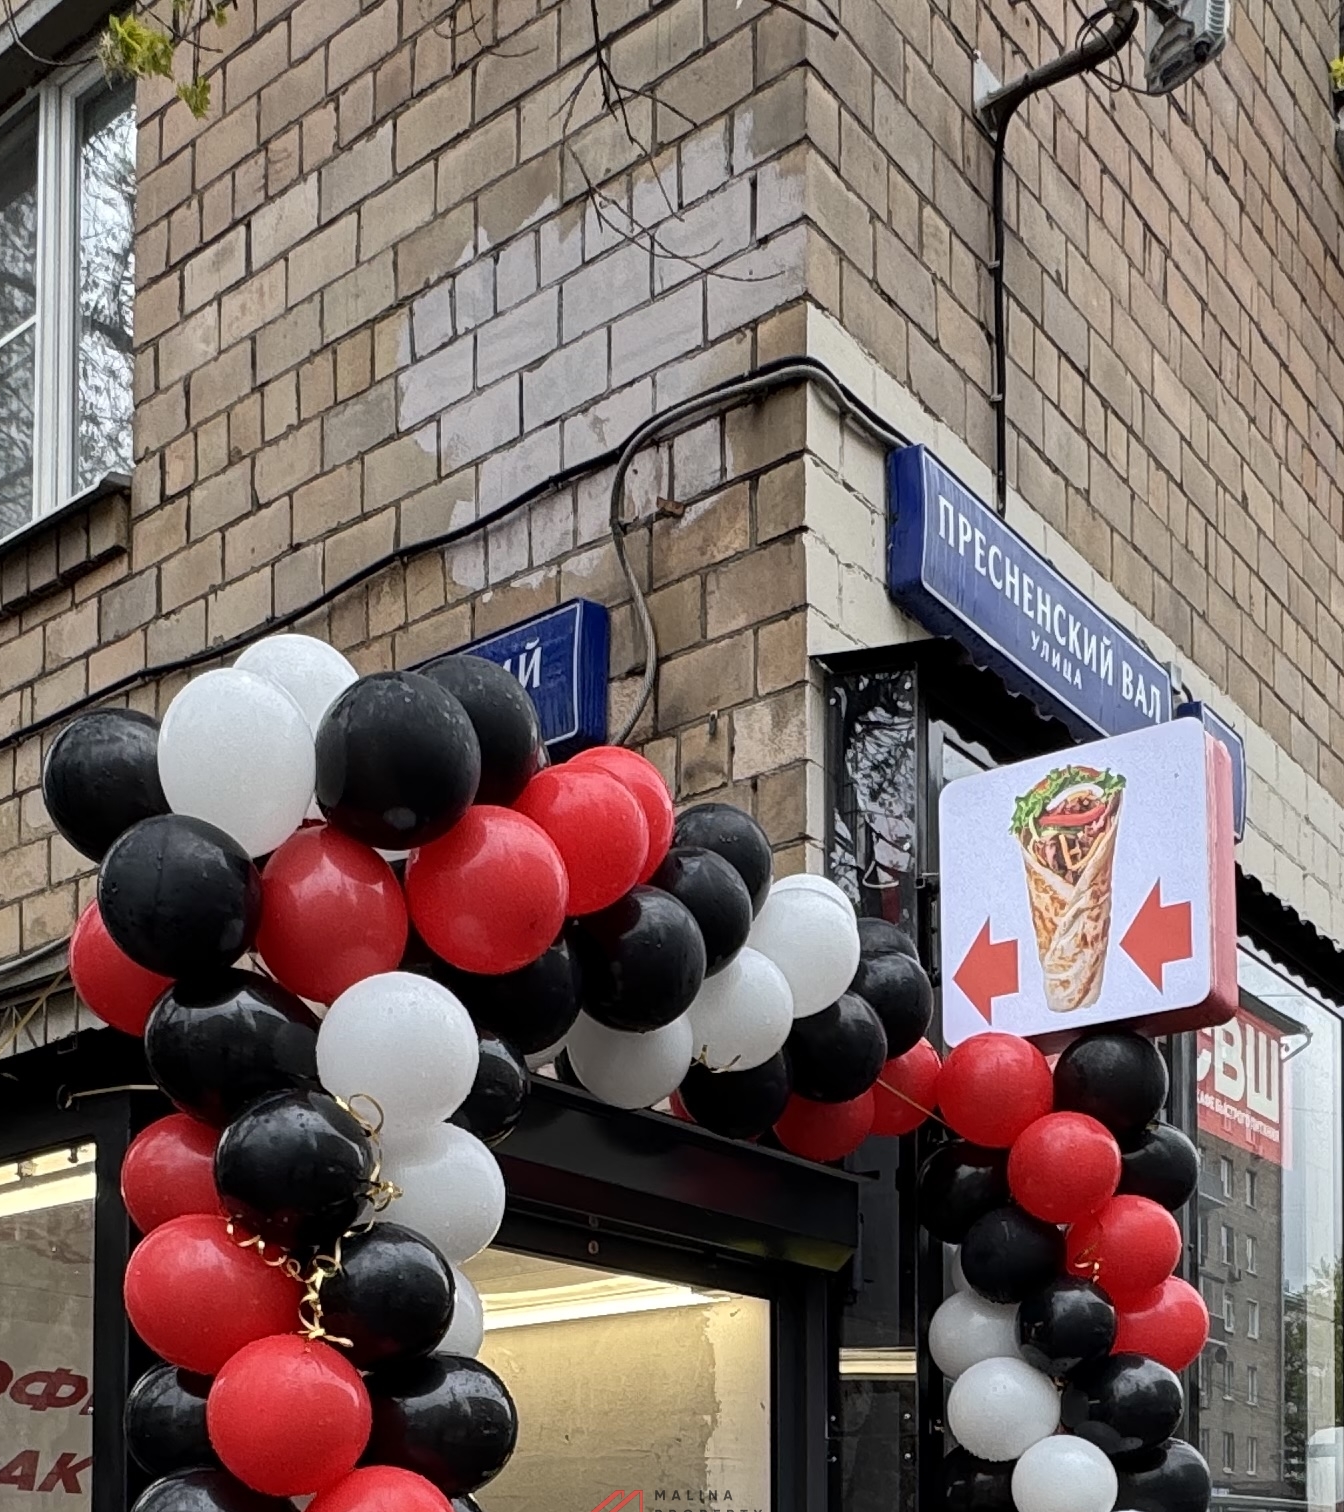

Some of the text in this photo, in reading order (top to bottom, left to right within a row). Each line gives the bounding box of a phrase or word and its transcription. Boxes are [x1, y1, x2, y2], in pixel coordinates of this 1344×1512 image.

[939, 495, 1162, 724] ПРЕСНЕНСКИЙ ВАЛ
[1030, 630, 1083, 690] УЛИЦА
